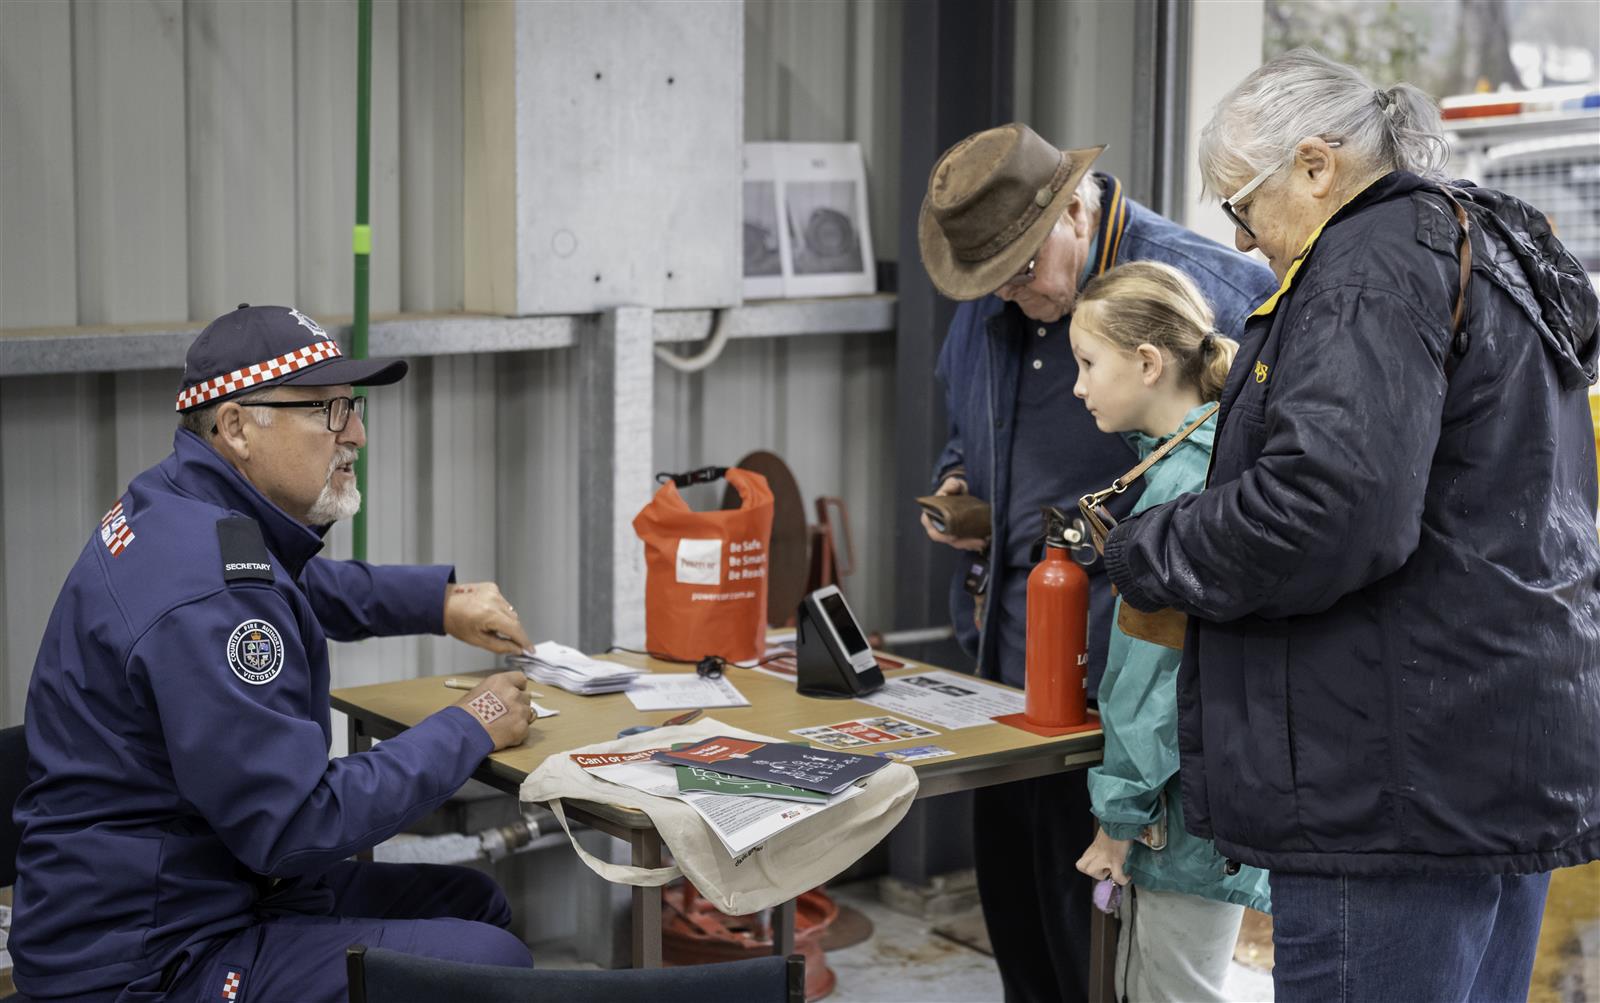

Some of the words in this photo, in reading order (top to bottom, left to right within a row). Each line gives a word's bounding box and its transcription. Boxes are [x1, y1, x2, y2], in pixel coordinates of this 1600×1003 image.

[730, 542, 742, 553] Be
[225, 562, 271, 571] SECRETARY
[729, 556, 741, 567] Be
[728, 570, 741, 581] Be
[230, 631, 241, 662] COUNTRY
[243, 623, 258, 631] FIRE
[262, 625, 281, 657] AUTHORITY
[243, 669, 276, 681] VICTORIA
[576, 756, 602, 765] Can
